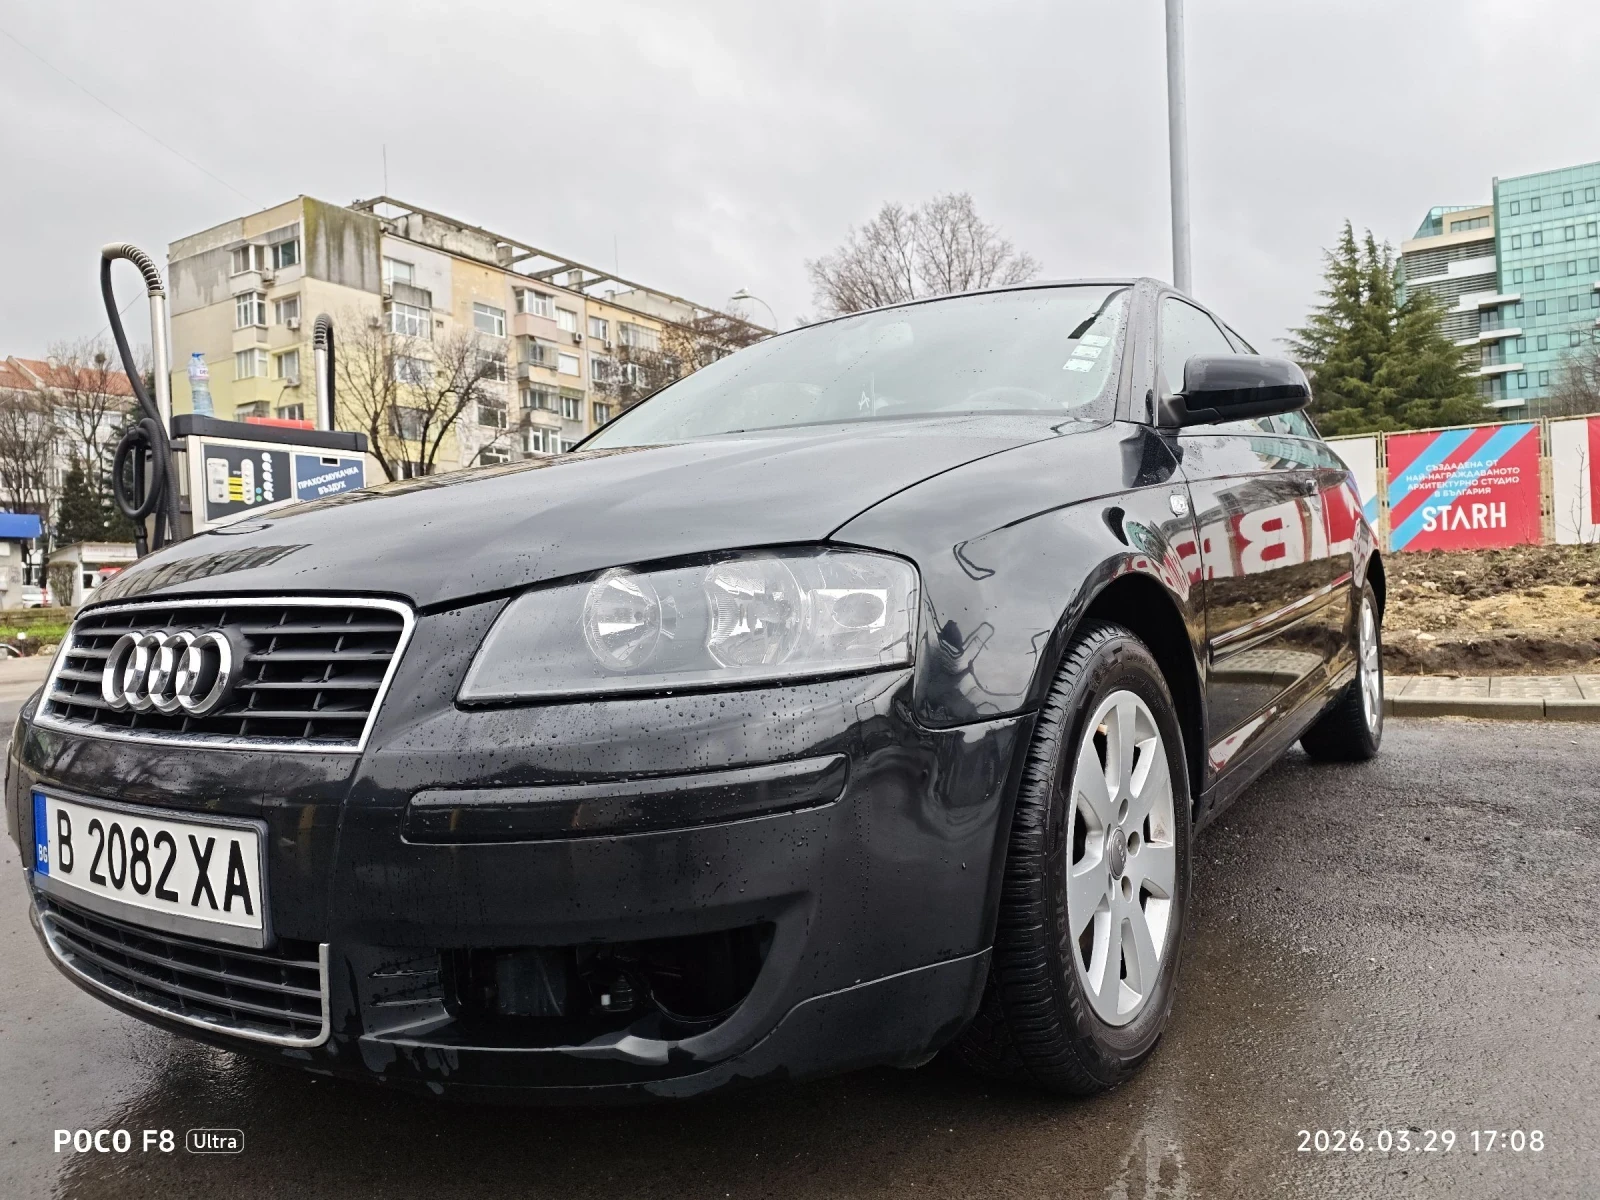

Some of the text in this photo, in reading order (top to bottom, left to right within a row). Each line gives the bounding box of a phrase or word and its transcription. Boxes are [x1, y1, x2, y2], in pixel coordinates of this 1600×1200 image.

[1425, 459, 1499, 472] СЪЗДАДЕНА ОТ
[297, 466, 359, 490] ПРАХОСМУКАЧКА
[1406, 467, 1520, 482] НАЙ-НАГРАЖДАВАНОТО
[317, 480, 346, 495] ВЪЗДУХ
[1407, 476, 1520, 491] АРХИТЕКТУРНО СТУДИО
[1443, 487, 1491, 497] БЪЛГАРИЯ
[38, 843, 48, 862] BG
[87, 818, 179, 903] 2082
